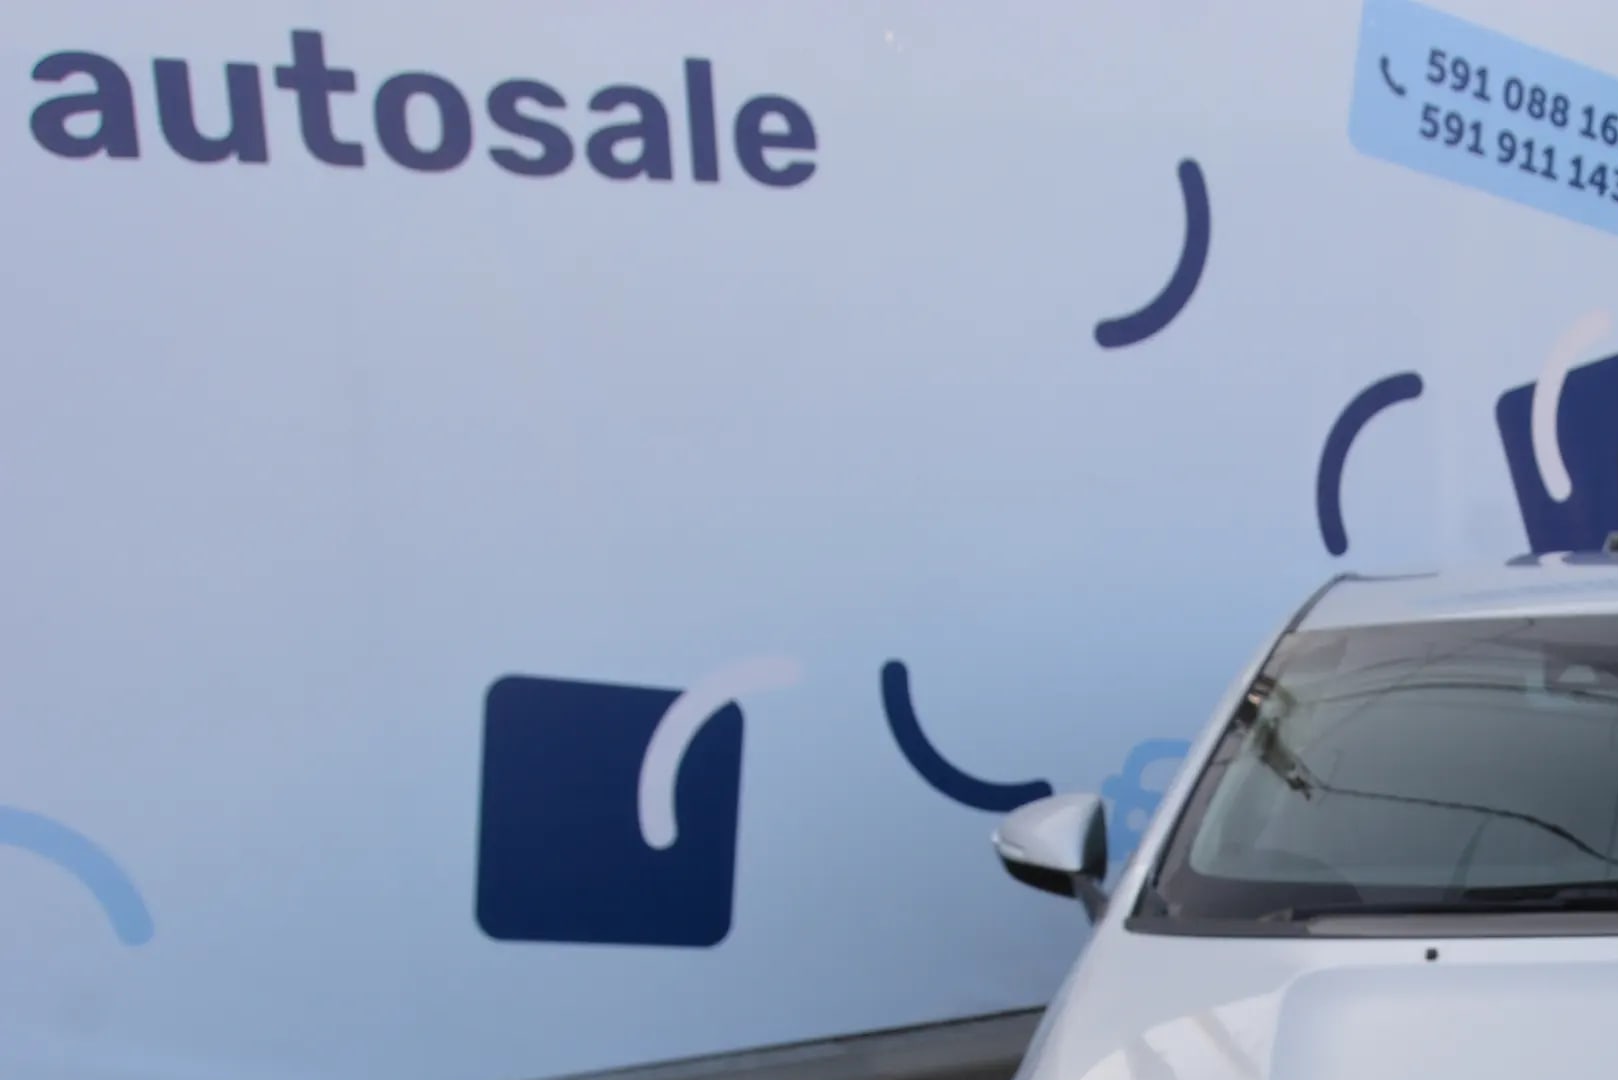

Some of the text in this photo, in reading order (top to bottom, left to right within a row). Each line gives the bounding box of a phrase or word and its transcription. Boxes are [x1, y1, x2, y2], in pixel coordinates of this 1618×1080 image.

[29, 29, 818, 189] autosale
[1425, 48, 1491, 102] 591
[1503, 77, 1570, 128] 088
[1419, 103, 1485, 156] 591
[1497, 130, 1558, 181] 911
